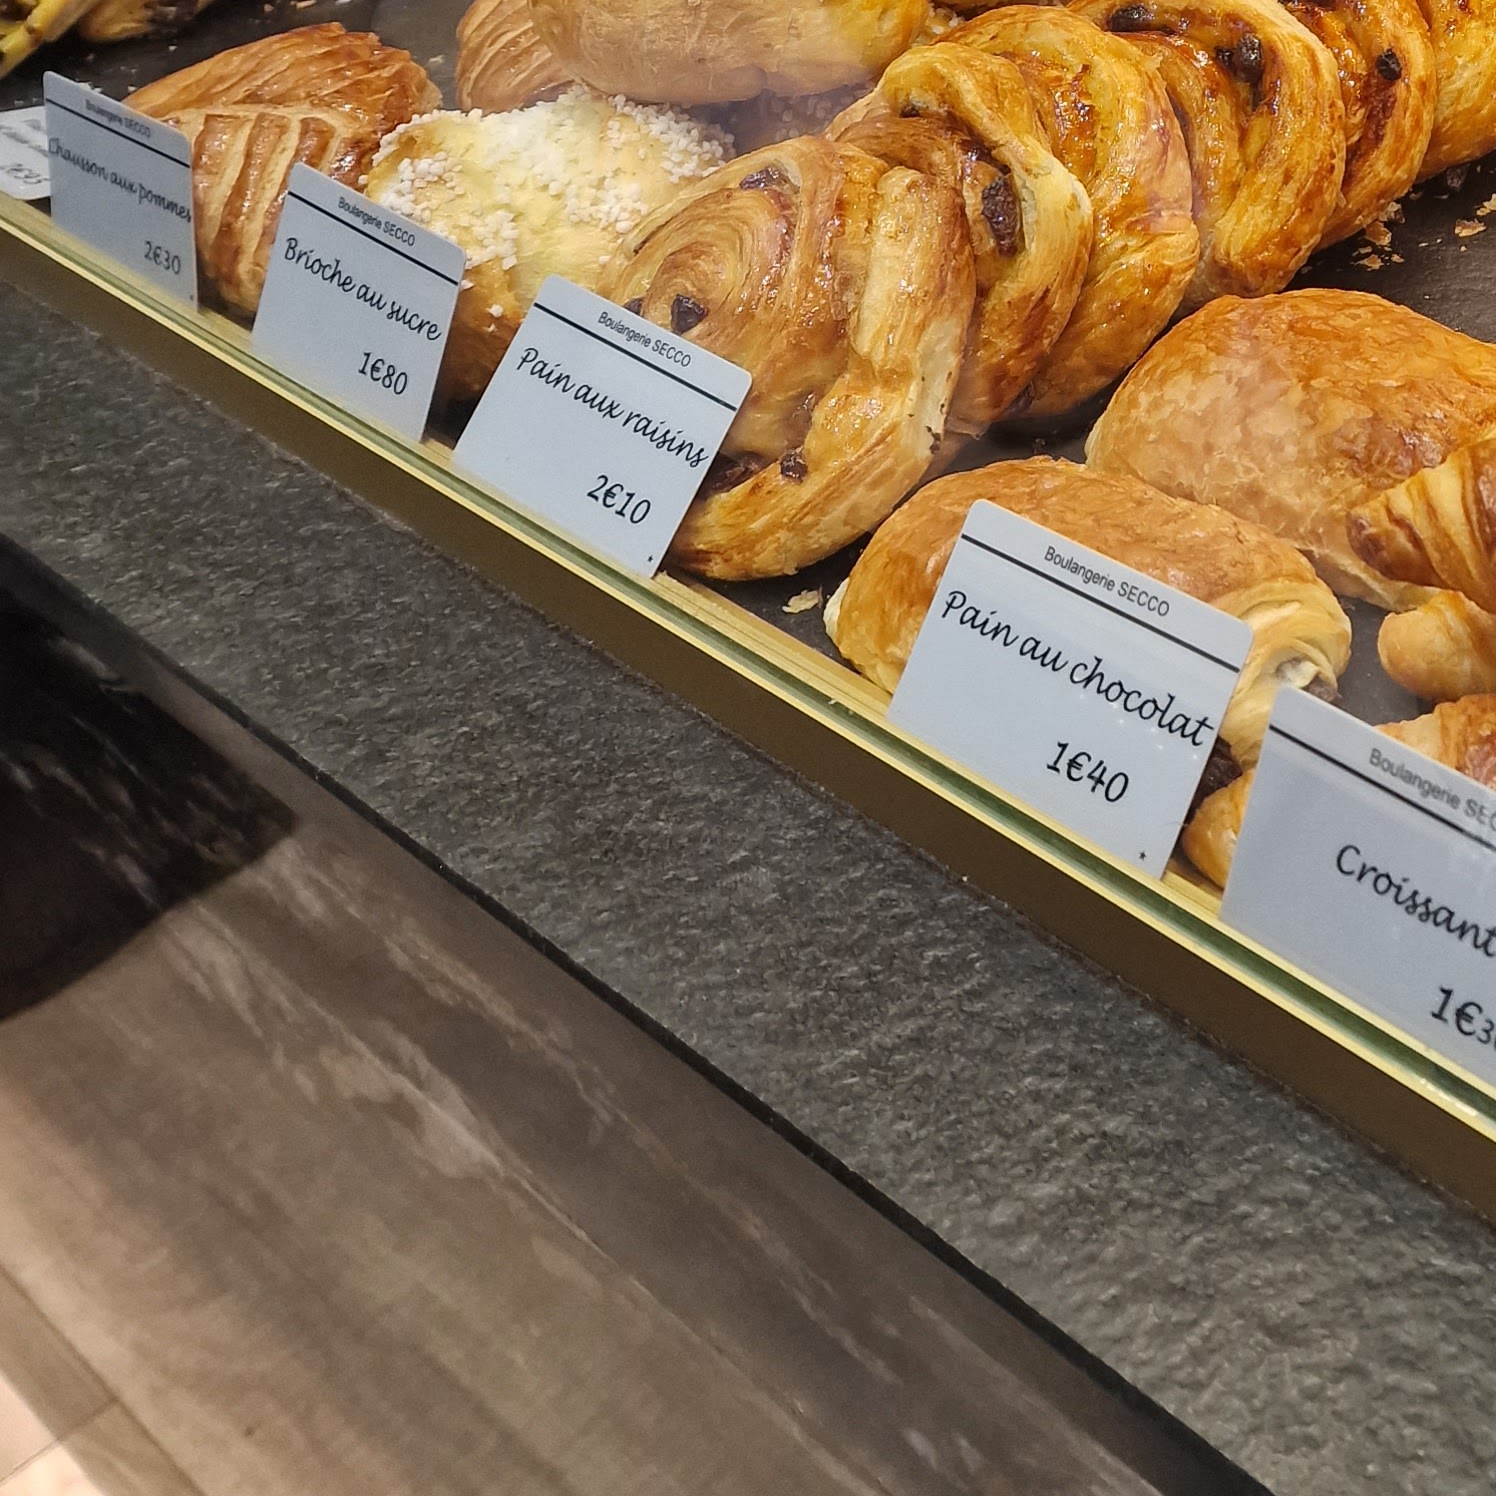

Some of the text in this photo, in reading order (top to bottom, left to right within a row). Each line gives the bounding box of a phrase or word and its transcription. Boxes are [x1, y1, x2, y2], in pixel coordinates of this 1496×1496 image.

[48, 137, 109, 181] Chausson
[110, 171, 138, 195] aux
[138, 183, 192, 224] pommes
[337, 196, 416, 248] Boulangerie SECCO
[143, 240, 181, 276] 2€30
[284, 237, 443, 342] Brioche au sucre
[597, 311, 693, 369] Boulangerie SECCO
[357, 351, 409, 396] 1€80
[515, 347, 710, 469] Pain aux raisins
[586, 474, 652, 525] 2€10
[1043, 545, 1171, 618] Boulangerie SECCO
[940, 590, 1215, 747] Pain au chocolat
[1046, 740, 1130, 804] 1€40
[1368, 747, 1462, 810] Boulangerie
